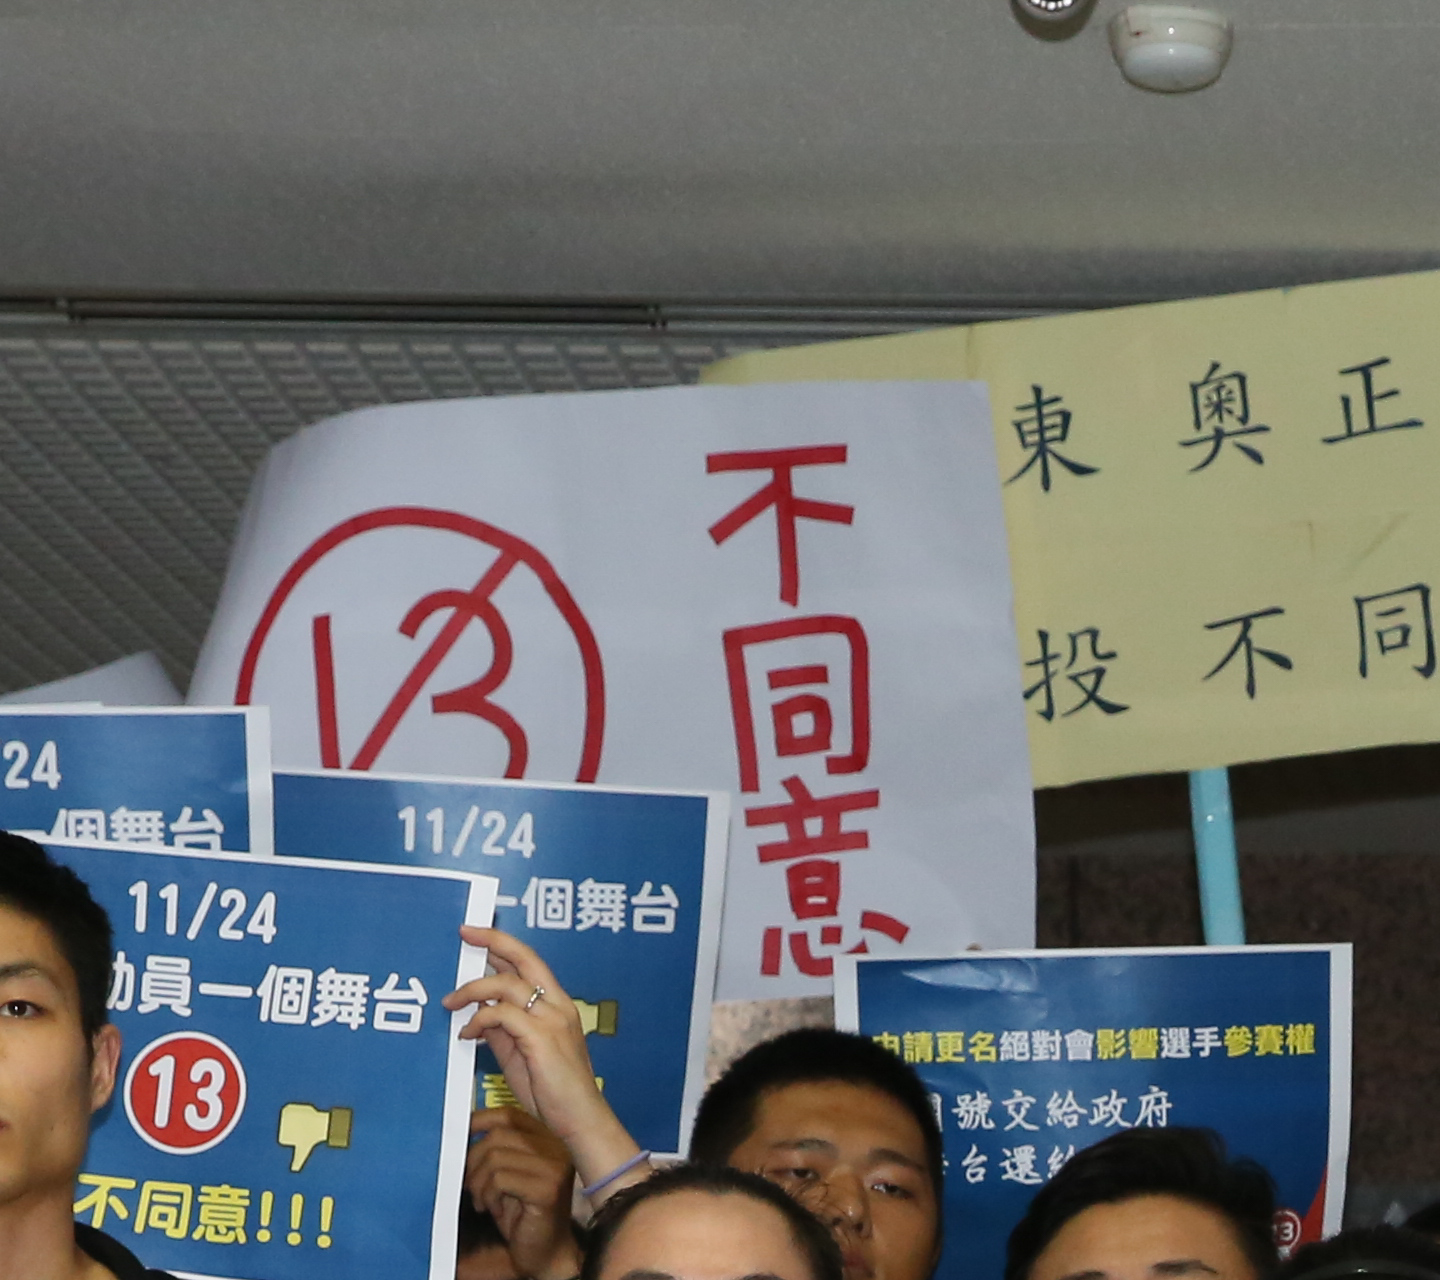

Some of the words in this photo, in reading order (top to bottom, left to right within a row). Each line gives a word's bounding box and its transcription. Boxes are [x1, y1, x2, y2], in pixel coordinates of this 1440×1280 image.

[705, 442, 908, 977] 不同意
[398, 805, 536, 858] 11/24
[129, 881, 277, 943] 11/24
[148, 1055, 225, 1132] 13
[930, 1084, 1173, 1133] 號交給政府
[73, 1173, 335, 1248] 不同意!!!
